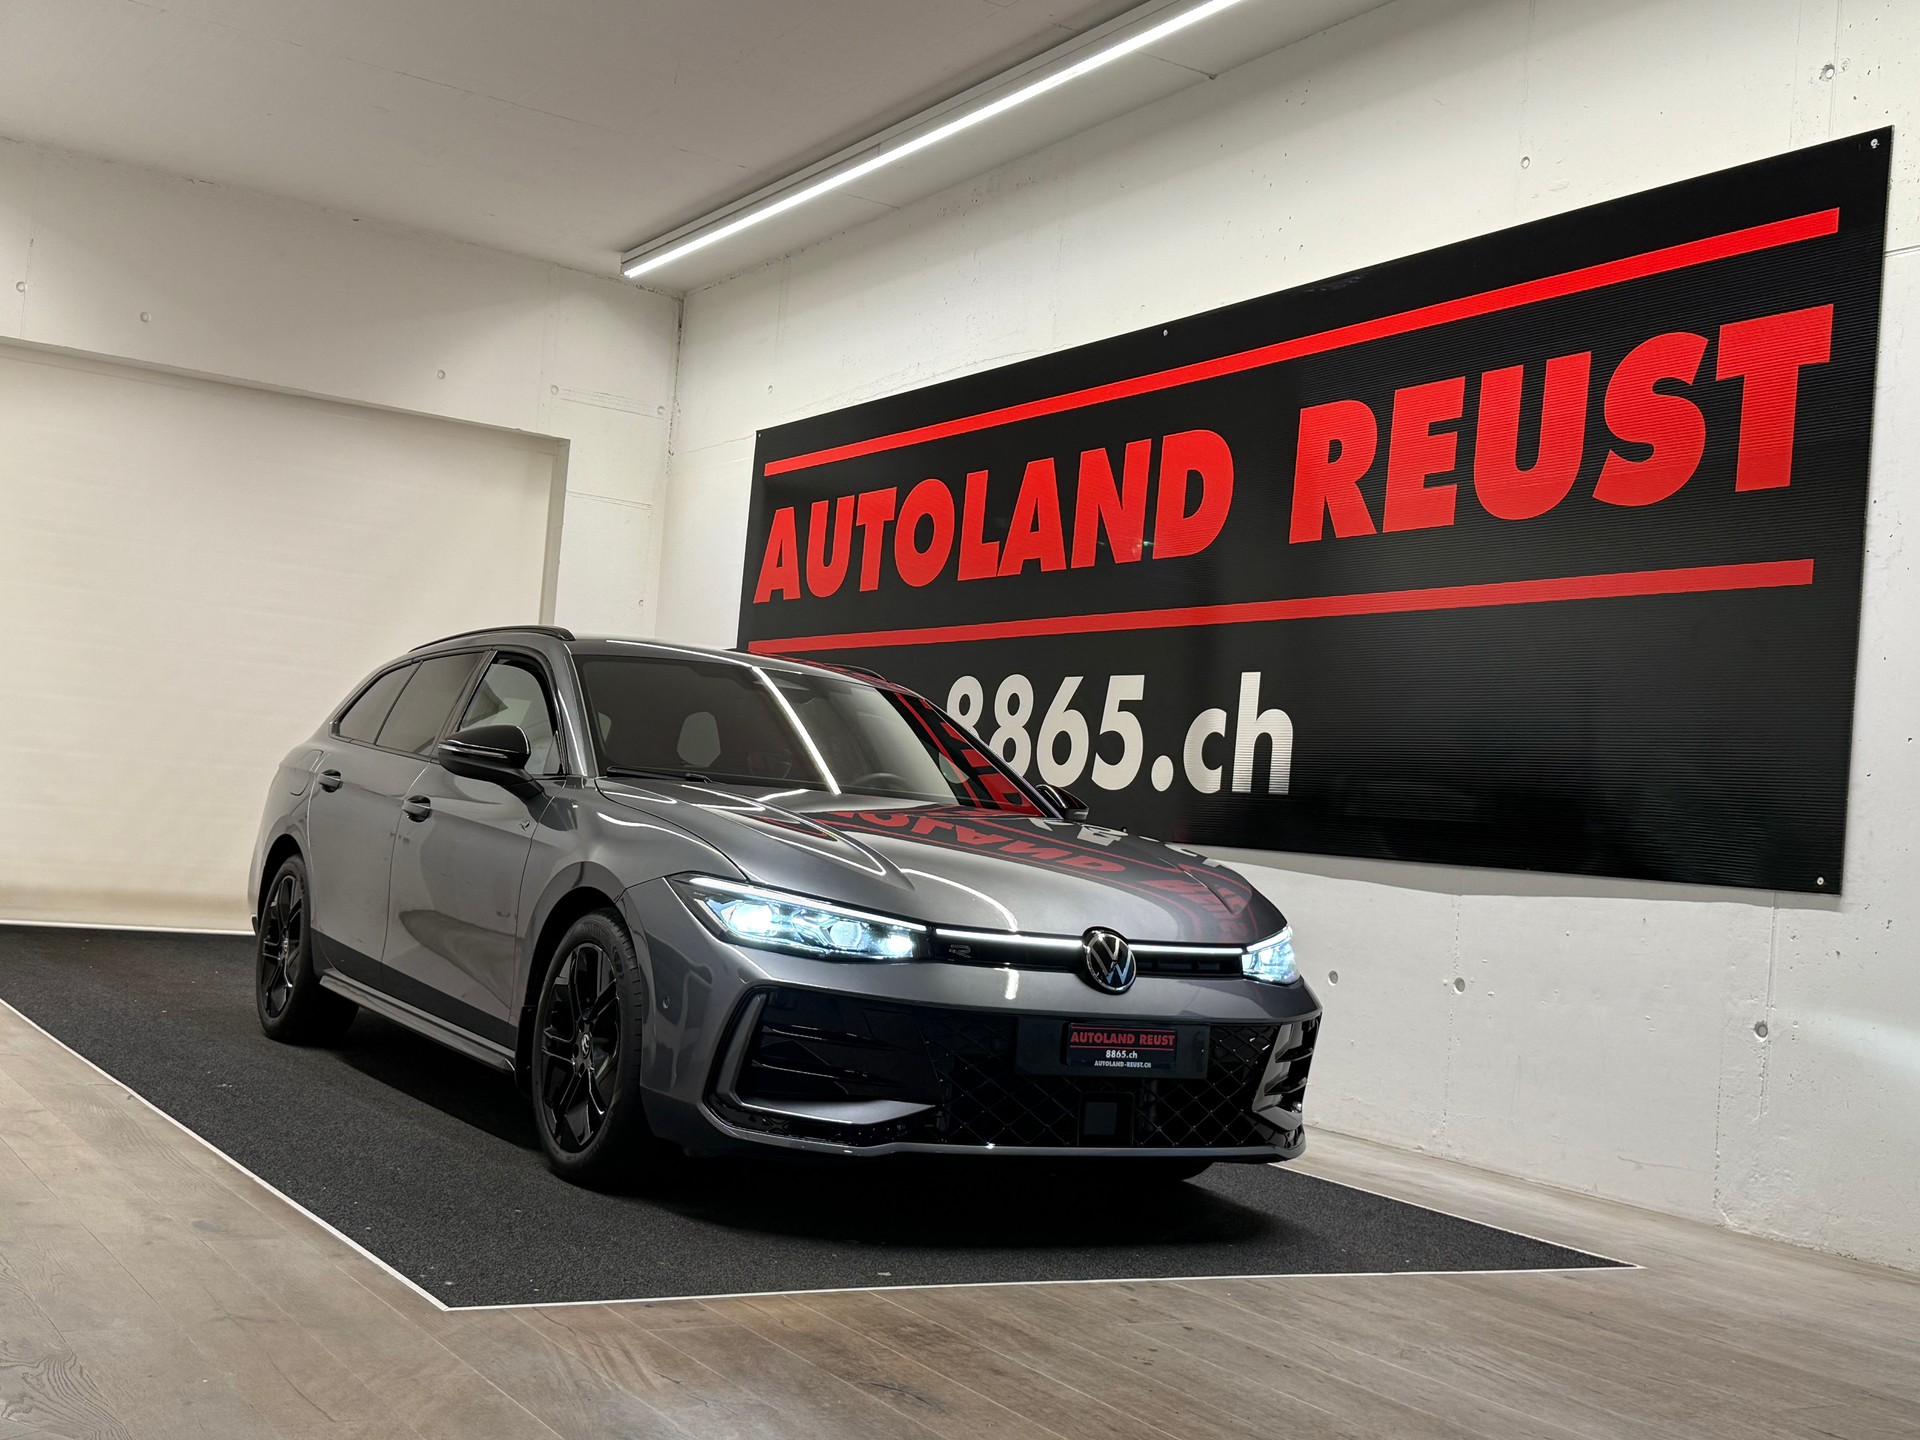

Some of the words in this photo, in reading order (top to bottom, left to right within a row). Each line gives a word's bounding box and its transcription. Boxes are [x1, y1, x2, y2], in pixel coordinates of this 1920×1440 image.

[754, 429, 1236, 605] AUTOLAND
[1289, 303, 1835, 546] REUST
[946, 671, 1294, 796] 8865.ch
[1070, 1031, 1135, 1044] AUTOLAND
[1139, 1034, 1175, 1046] REUST
[1105, 1049, 1138, 1059] 8865.ch
[1094, 1060, 1152, 1068] AUTOLAND-REUST.CH
